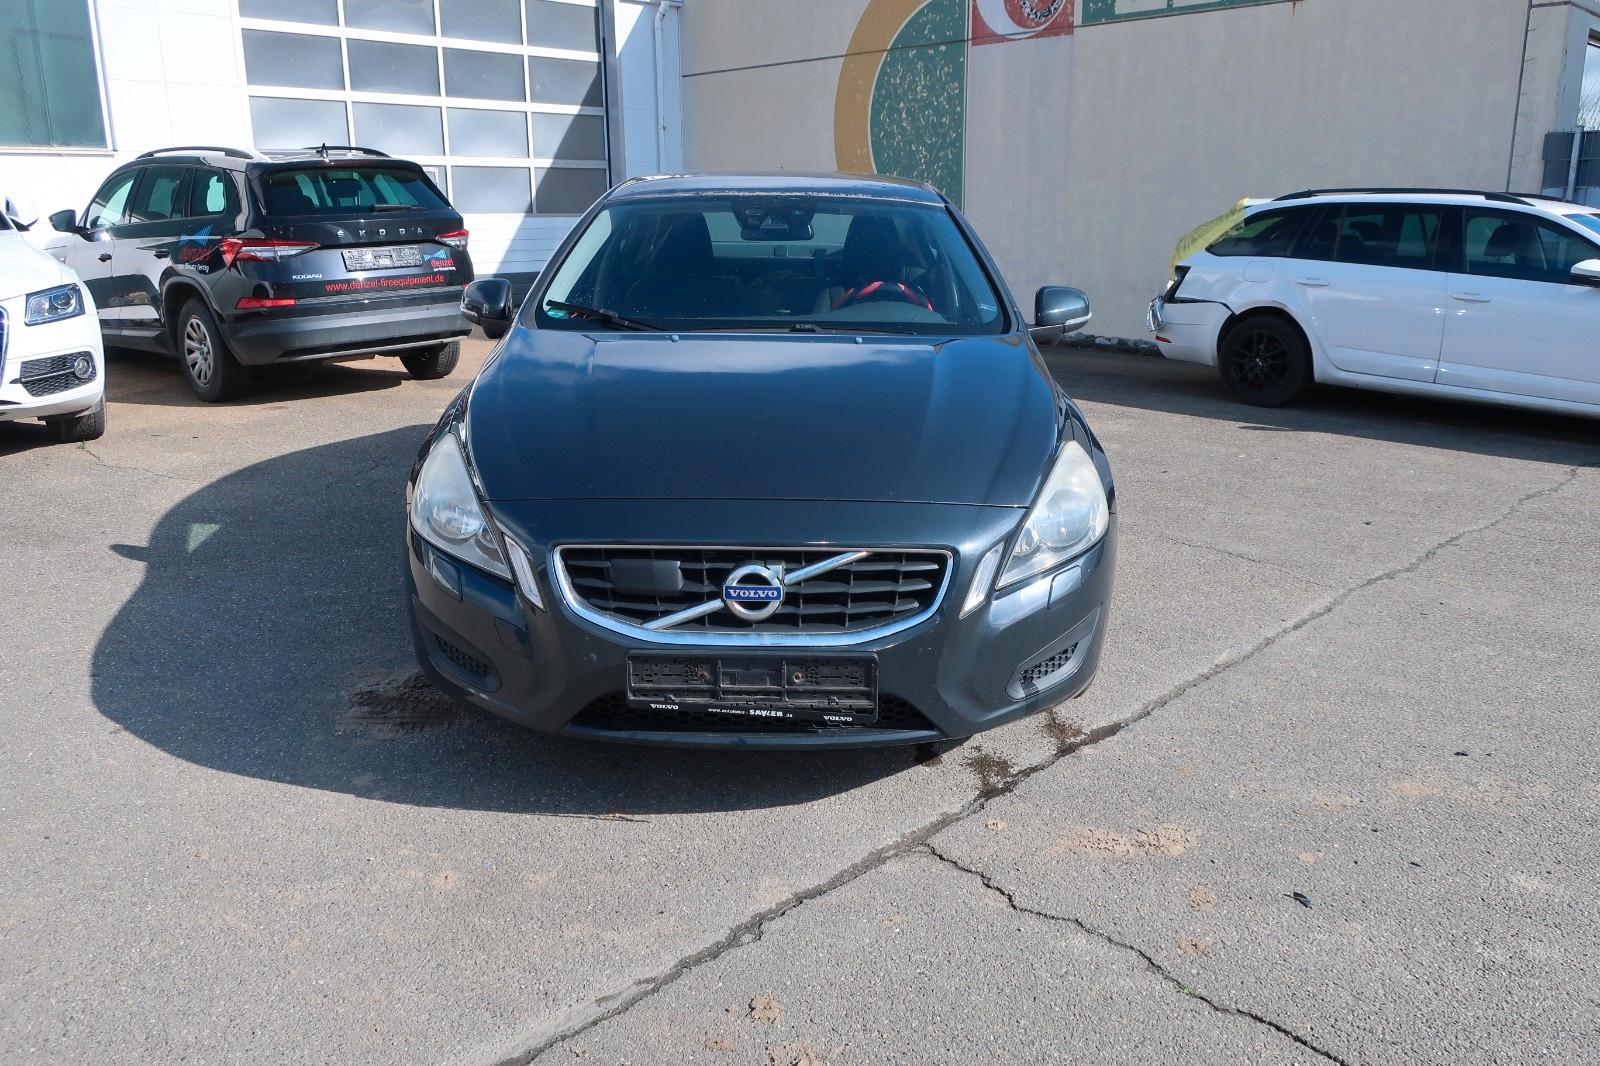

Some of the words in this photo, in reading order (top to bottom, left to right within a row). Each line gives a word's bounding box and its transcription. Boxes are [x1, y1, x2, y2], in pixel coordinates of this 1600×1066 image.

[430, 257, 454, 267] denzel
[325, 274, 444, 291] www.denzel-fireequipment.de
[727, 588, 778, 598] VOLVO
